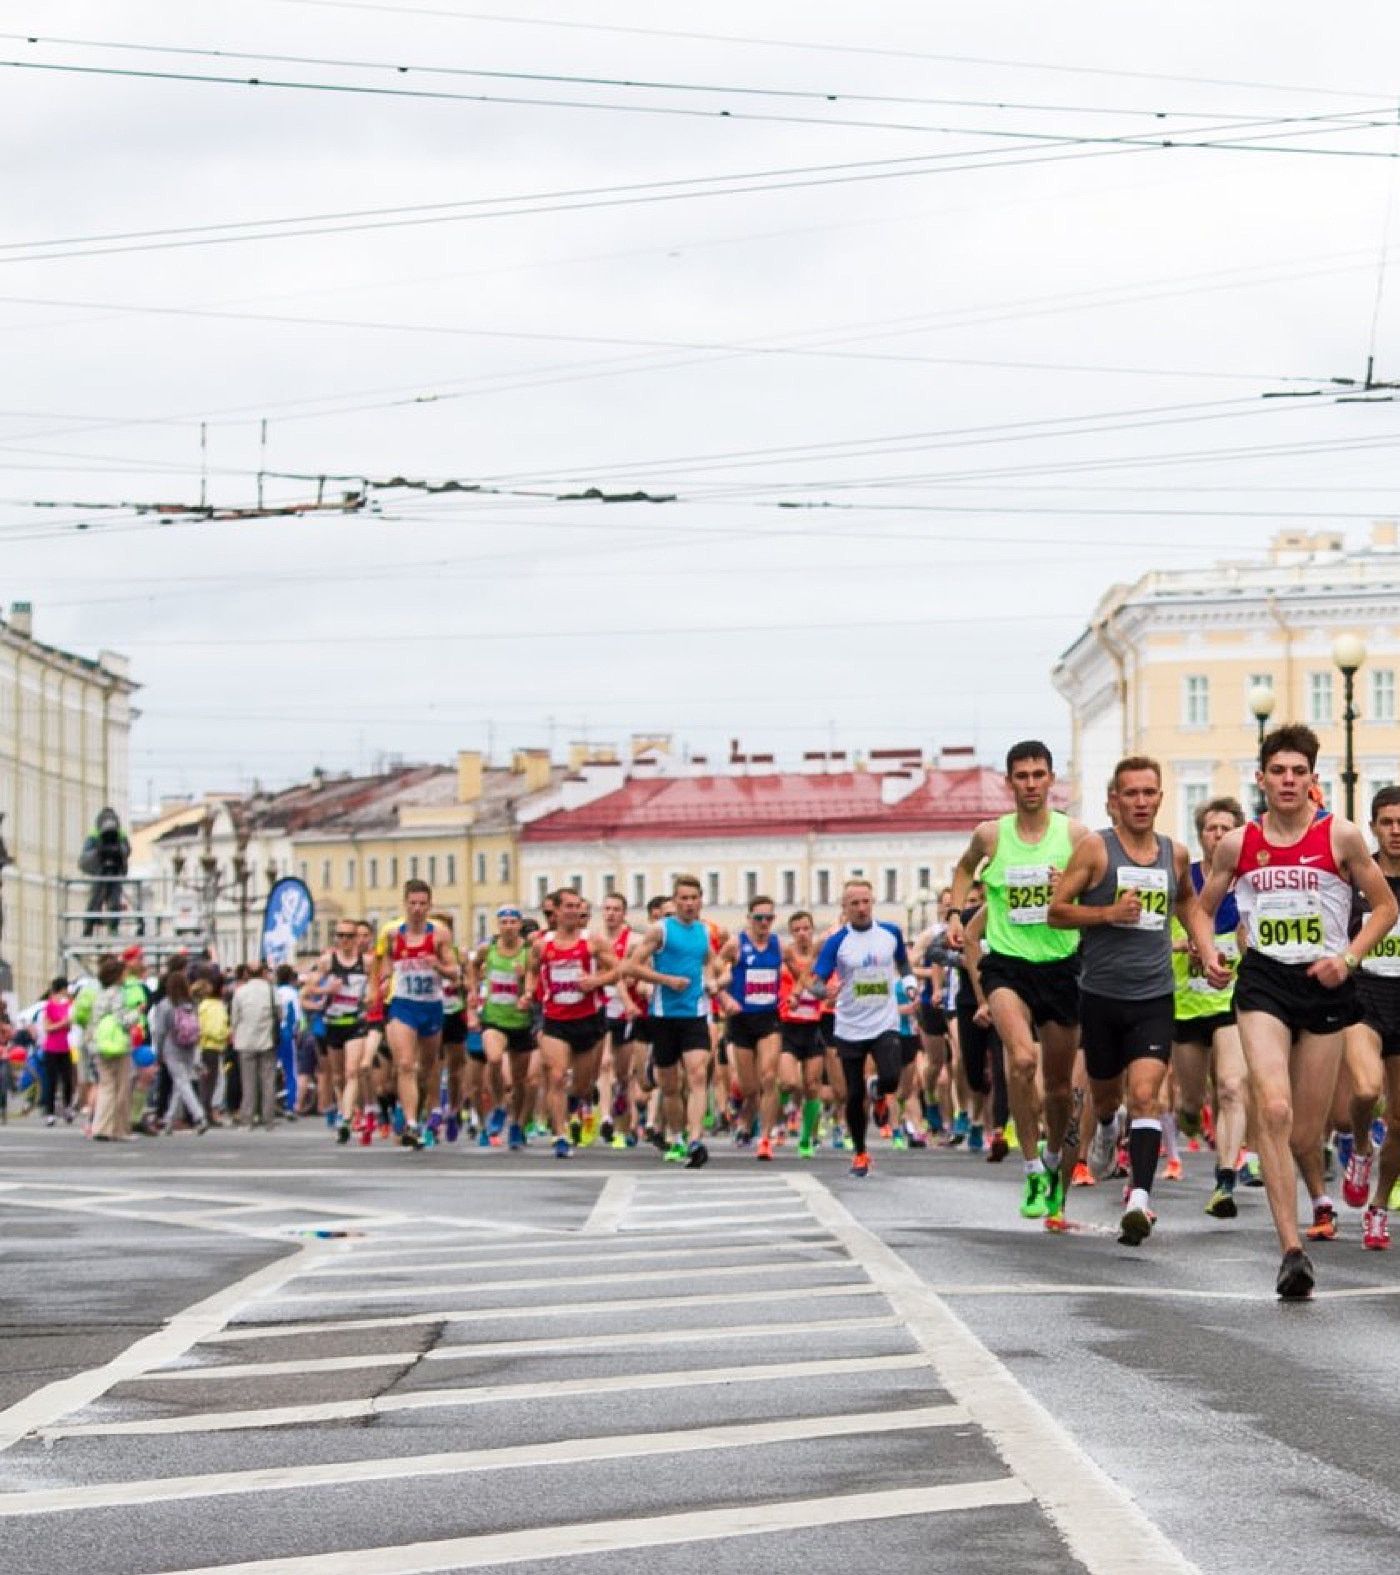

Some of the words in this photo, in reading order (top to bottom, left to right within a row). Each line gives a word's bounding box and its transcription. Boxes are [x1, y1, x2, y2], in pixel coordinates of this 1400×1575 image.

[1252, 869, 1319, 893] RUSSIA
[1260, 918, 1321, 946] 9015
[405, 974, 434, 995] 132
